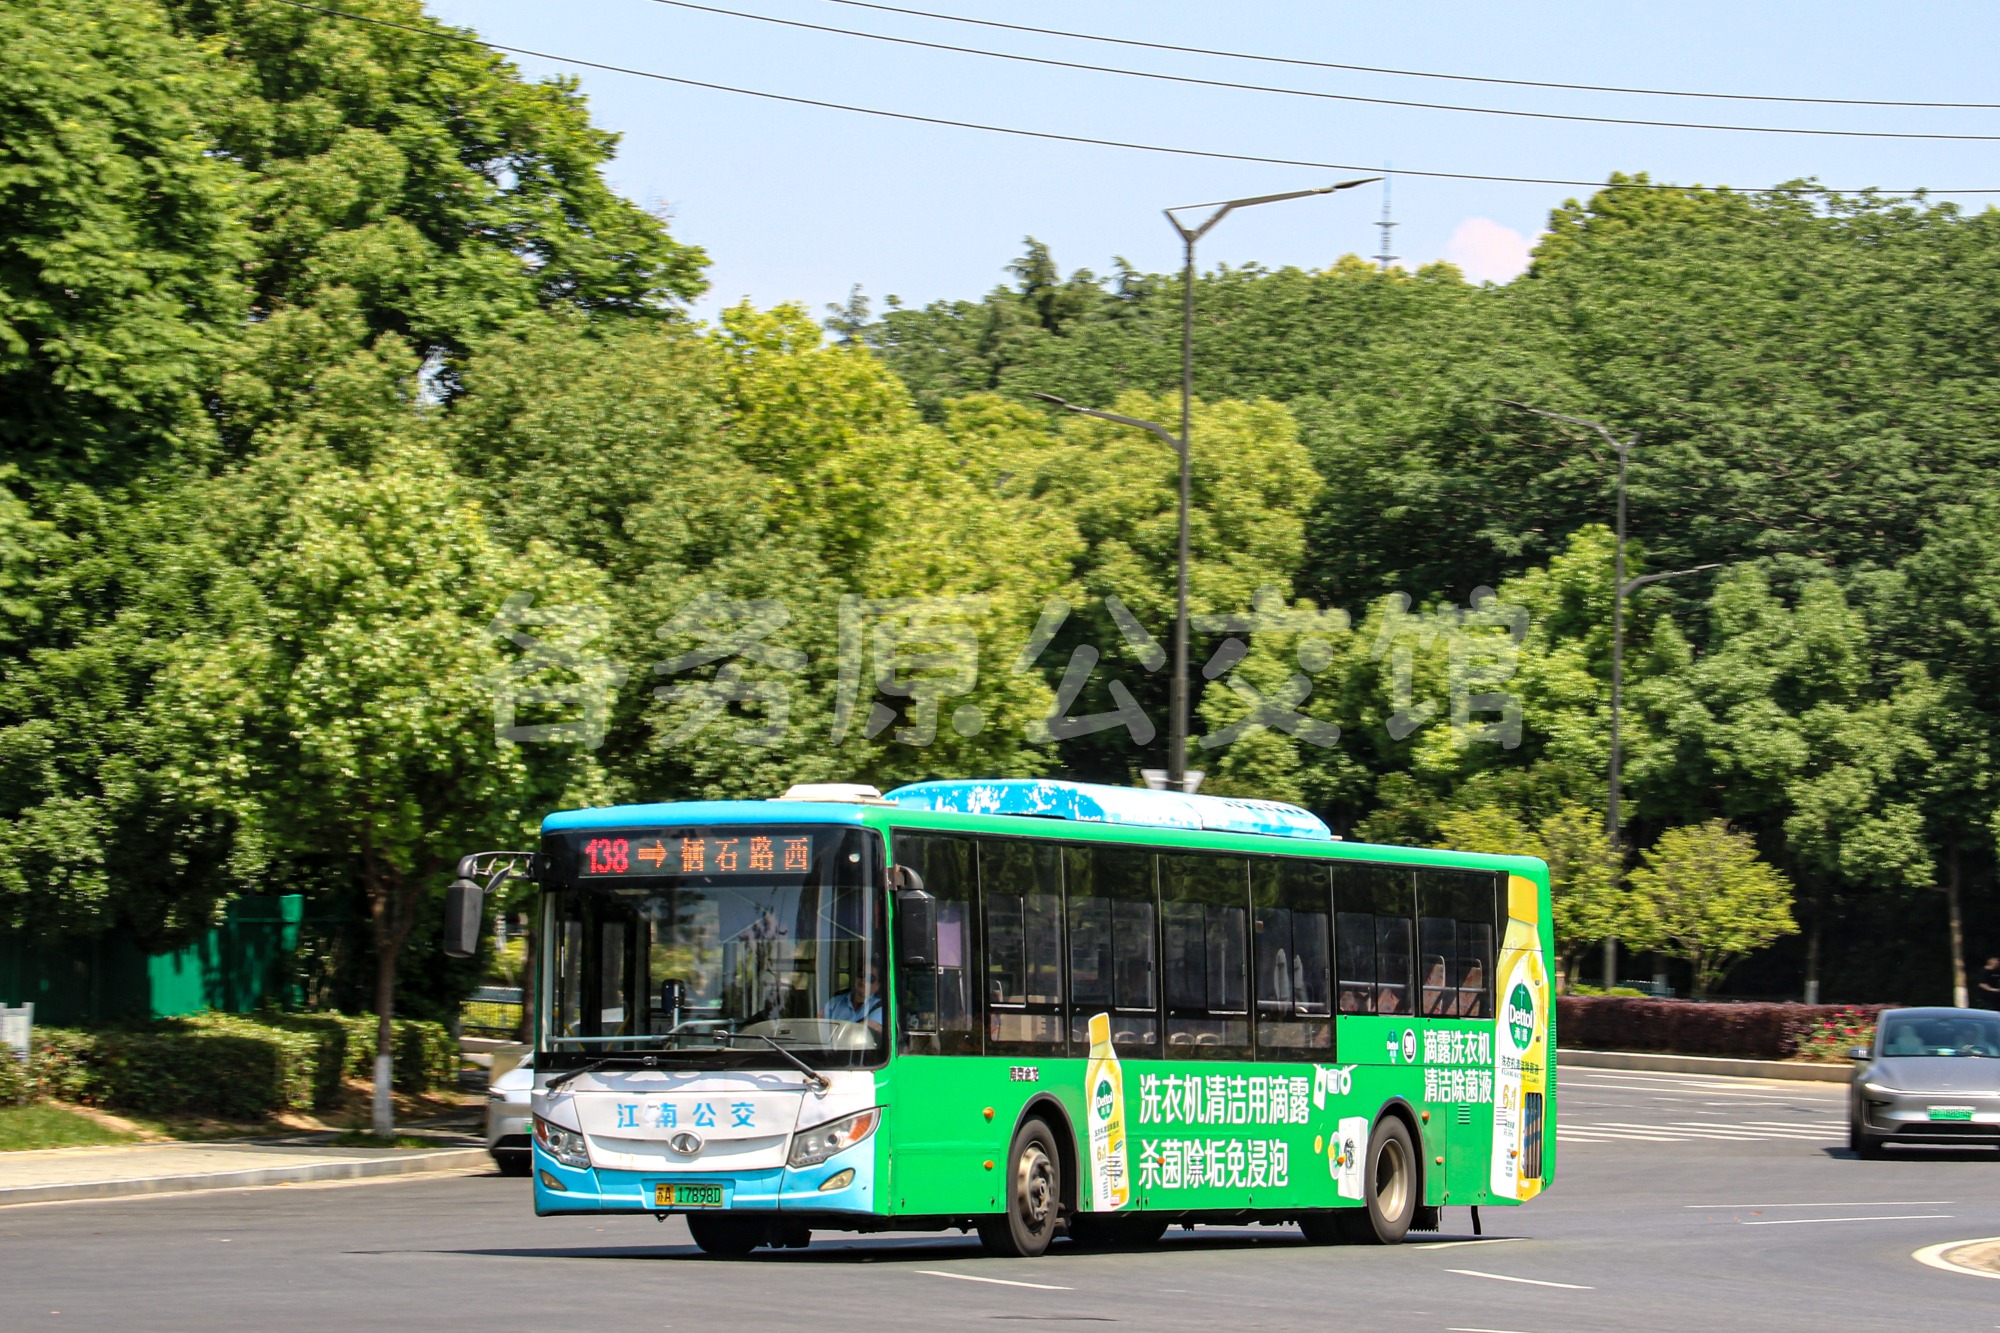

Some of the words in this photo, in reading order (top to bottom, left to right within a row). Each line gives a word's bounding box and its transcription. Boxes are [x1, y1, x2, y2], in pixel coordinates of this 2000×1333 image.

[585, 838, 629, 873] 138
[1509, 1003, 1533, 1029] Dettol
[1423, 1029, 1492, 1065] 滴露洗衣机
[1096, 1092, 1113, 1109] Dettol
[1139, 1073, 1310, 1125] 洗衣机清洁用滴露
[1424, 1068, 1493, 1104] 清洁除菌液
[616, 1102, 756, 1129] 江南公交
[1139, 1138, 1289, 1190] 杀菌除垢免浸泡
